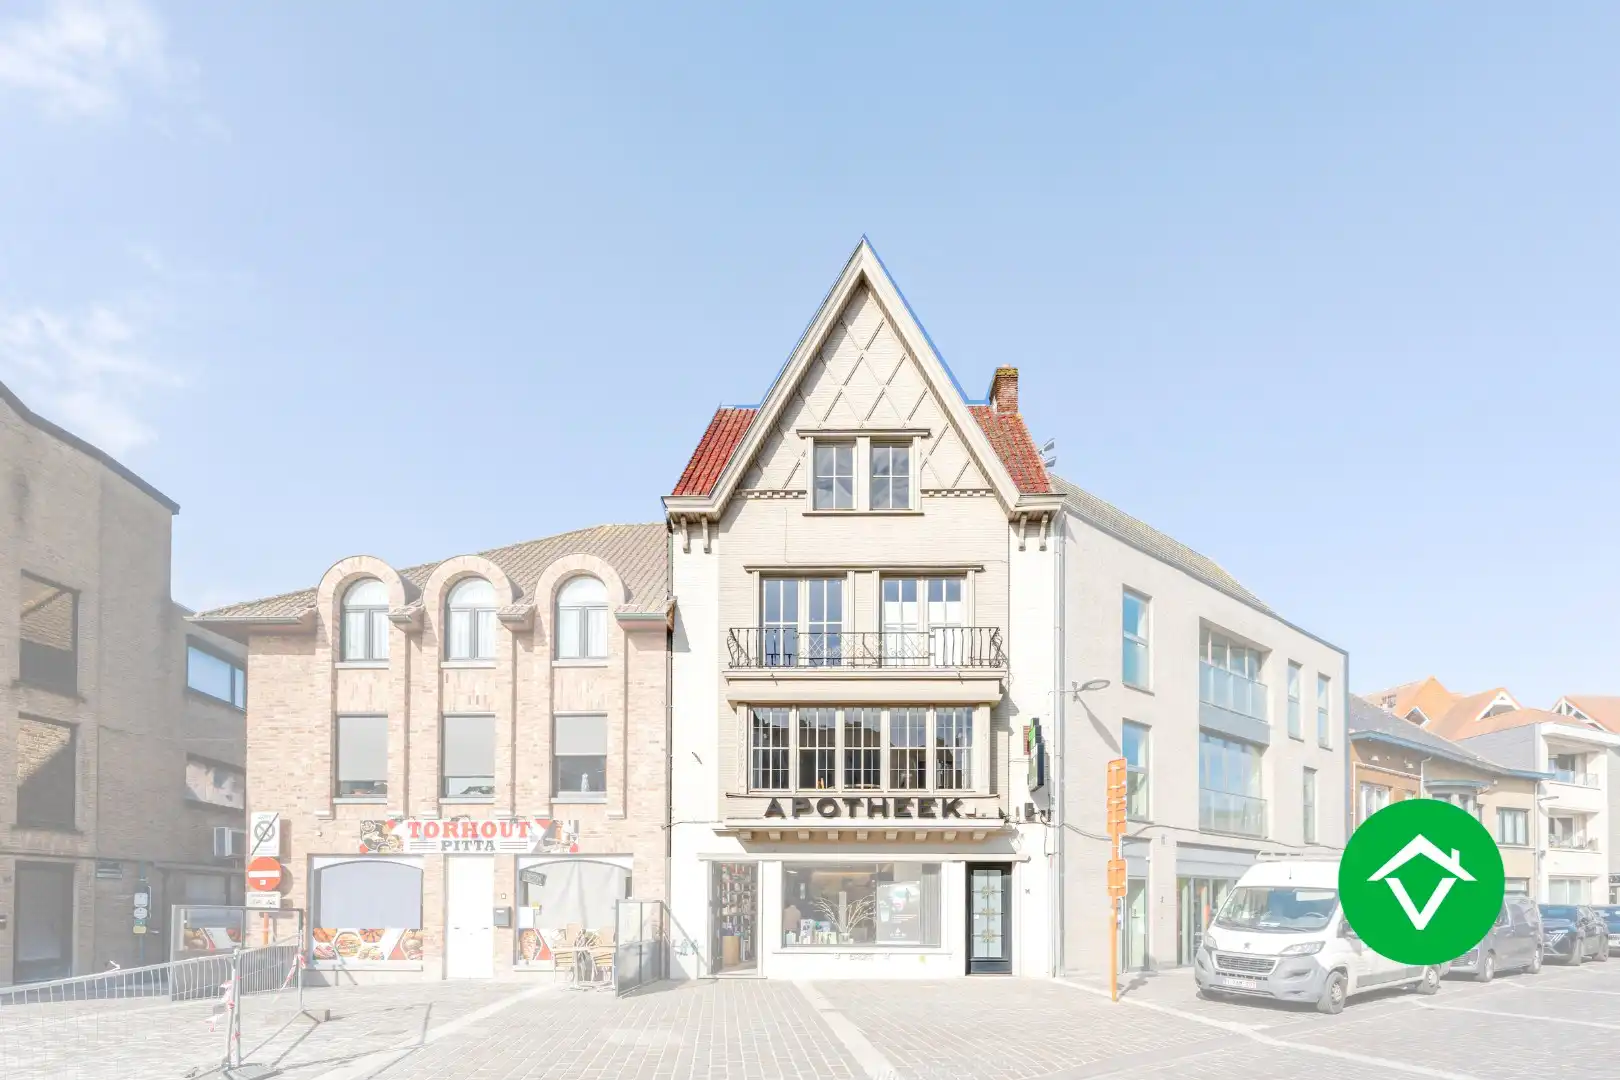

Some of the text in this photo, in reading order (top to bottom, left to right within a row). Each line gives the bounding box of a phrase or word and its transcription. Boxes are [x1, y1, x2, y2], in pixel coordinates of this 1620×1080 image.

[764, 797, 962, 818] APOTHEEK
[407, 821, 530, 838] TORHOUT
[441, 840, 496, 851] PITTA
